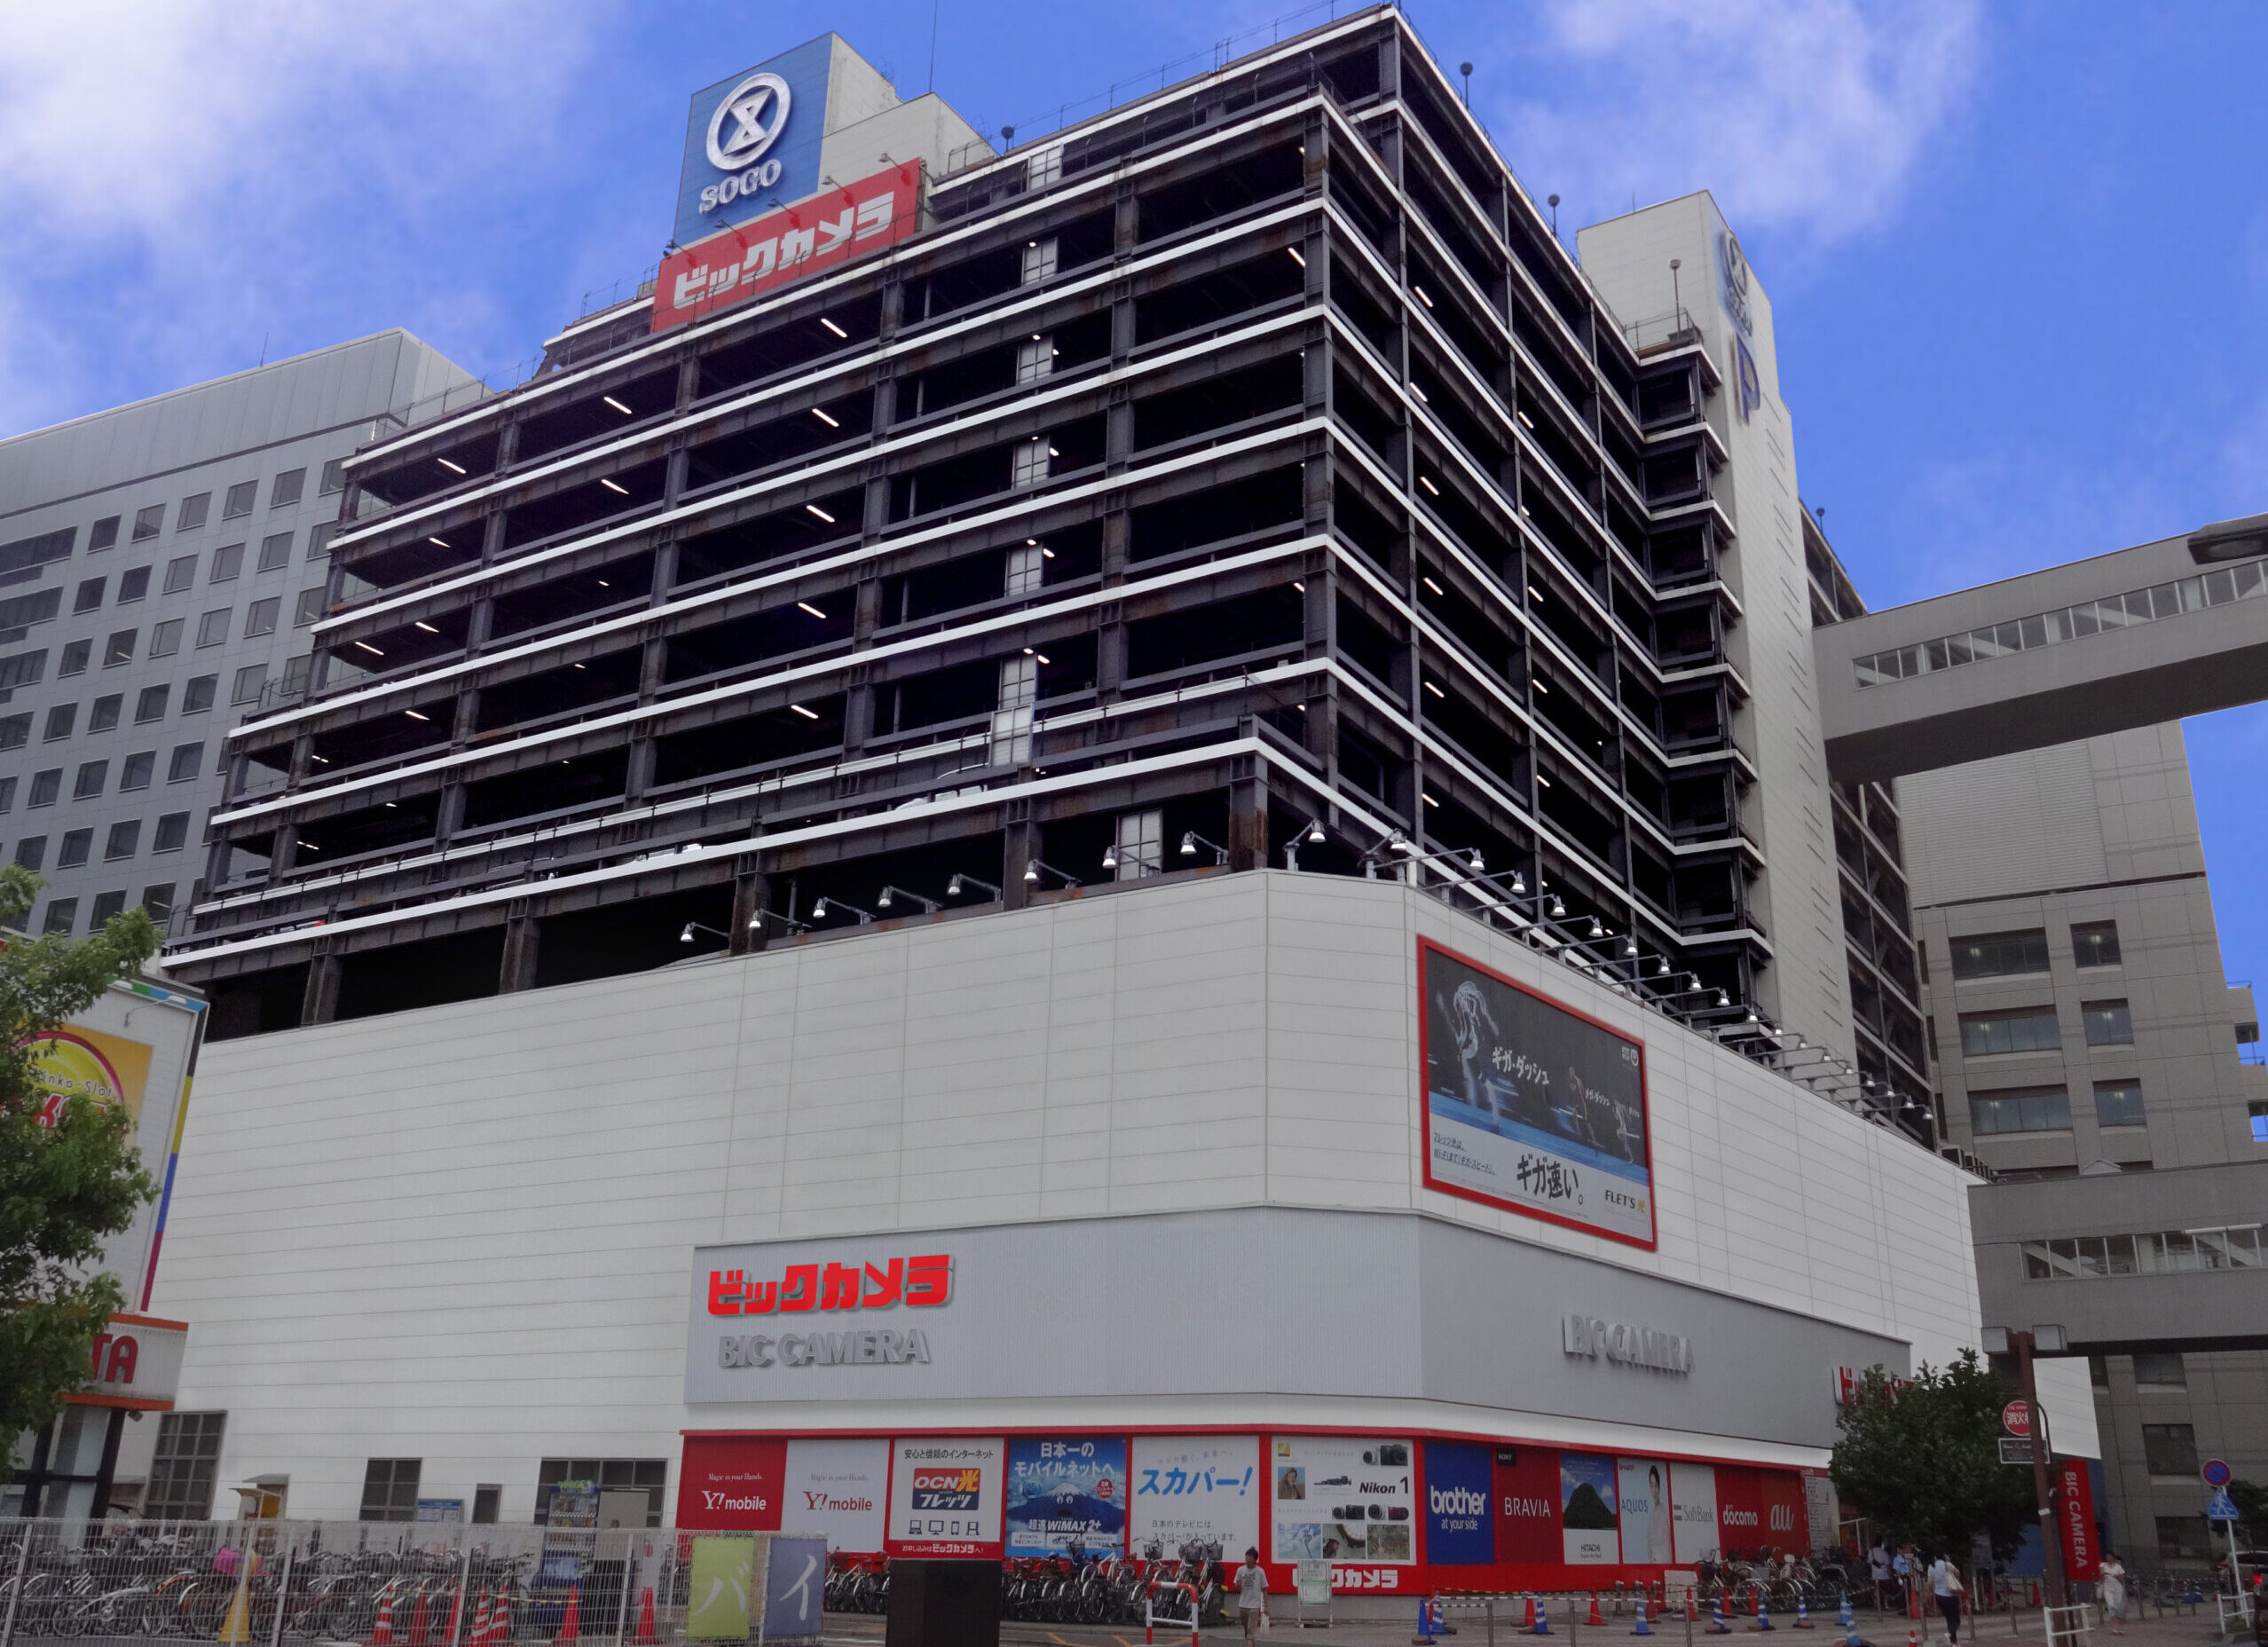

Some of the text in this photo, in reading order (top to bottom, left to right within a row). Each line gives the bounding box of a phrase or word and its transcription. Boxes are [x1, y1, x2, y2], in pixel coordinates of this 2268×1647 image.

[698, 159, 782, 214] SOGO
[673, 191, 894, 310] ビックカメラ
[1516, 1154, 1584, 1205] ギガ速い。
[708, 1254, 953, 1316] ビックカメラ
[92, 1333, 138, 1384] TA
[717, 1329, 929, 1367] BIC CAMERA
[1563, 1314, 1696, 1374] BIC CAMERA
[1041, 1441, 1095, 1458] 日本一の
[920, 1493, 972, 1509] フレッツ
[1359, 1477, 1409, 1494] Nikon 1
[1429, 1485, 1486, 1516] brother
[1504, 1497, 1551, 1517] BRAVIA
[1621, 1499, 1649, 1516] AQUOS
[1723, 1505, 1759, 1526] docomo
[1770, 1504, 1794, 1531] au
[2065, 1471, 2088, 1568] BIC CAMERA
[1441, 1517, 1478, 1533] at your side
[696, 1561, 750, 1615] バ
[778, 1555, 817, 1620] イ
[1292, 1568, 1398, 1588] クカメラ
